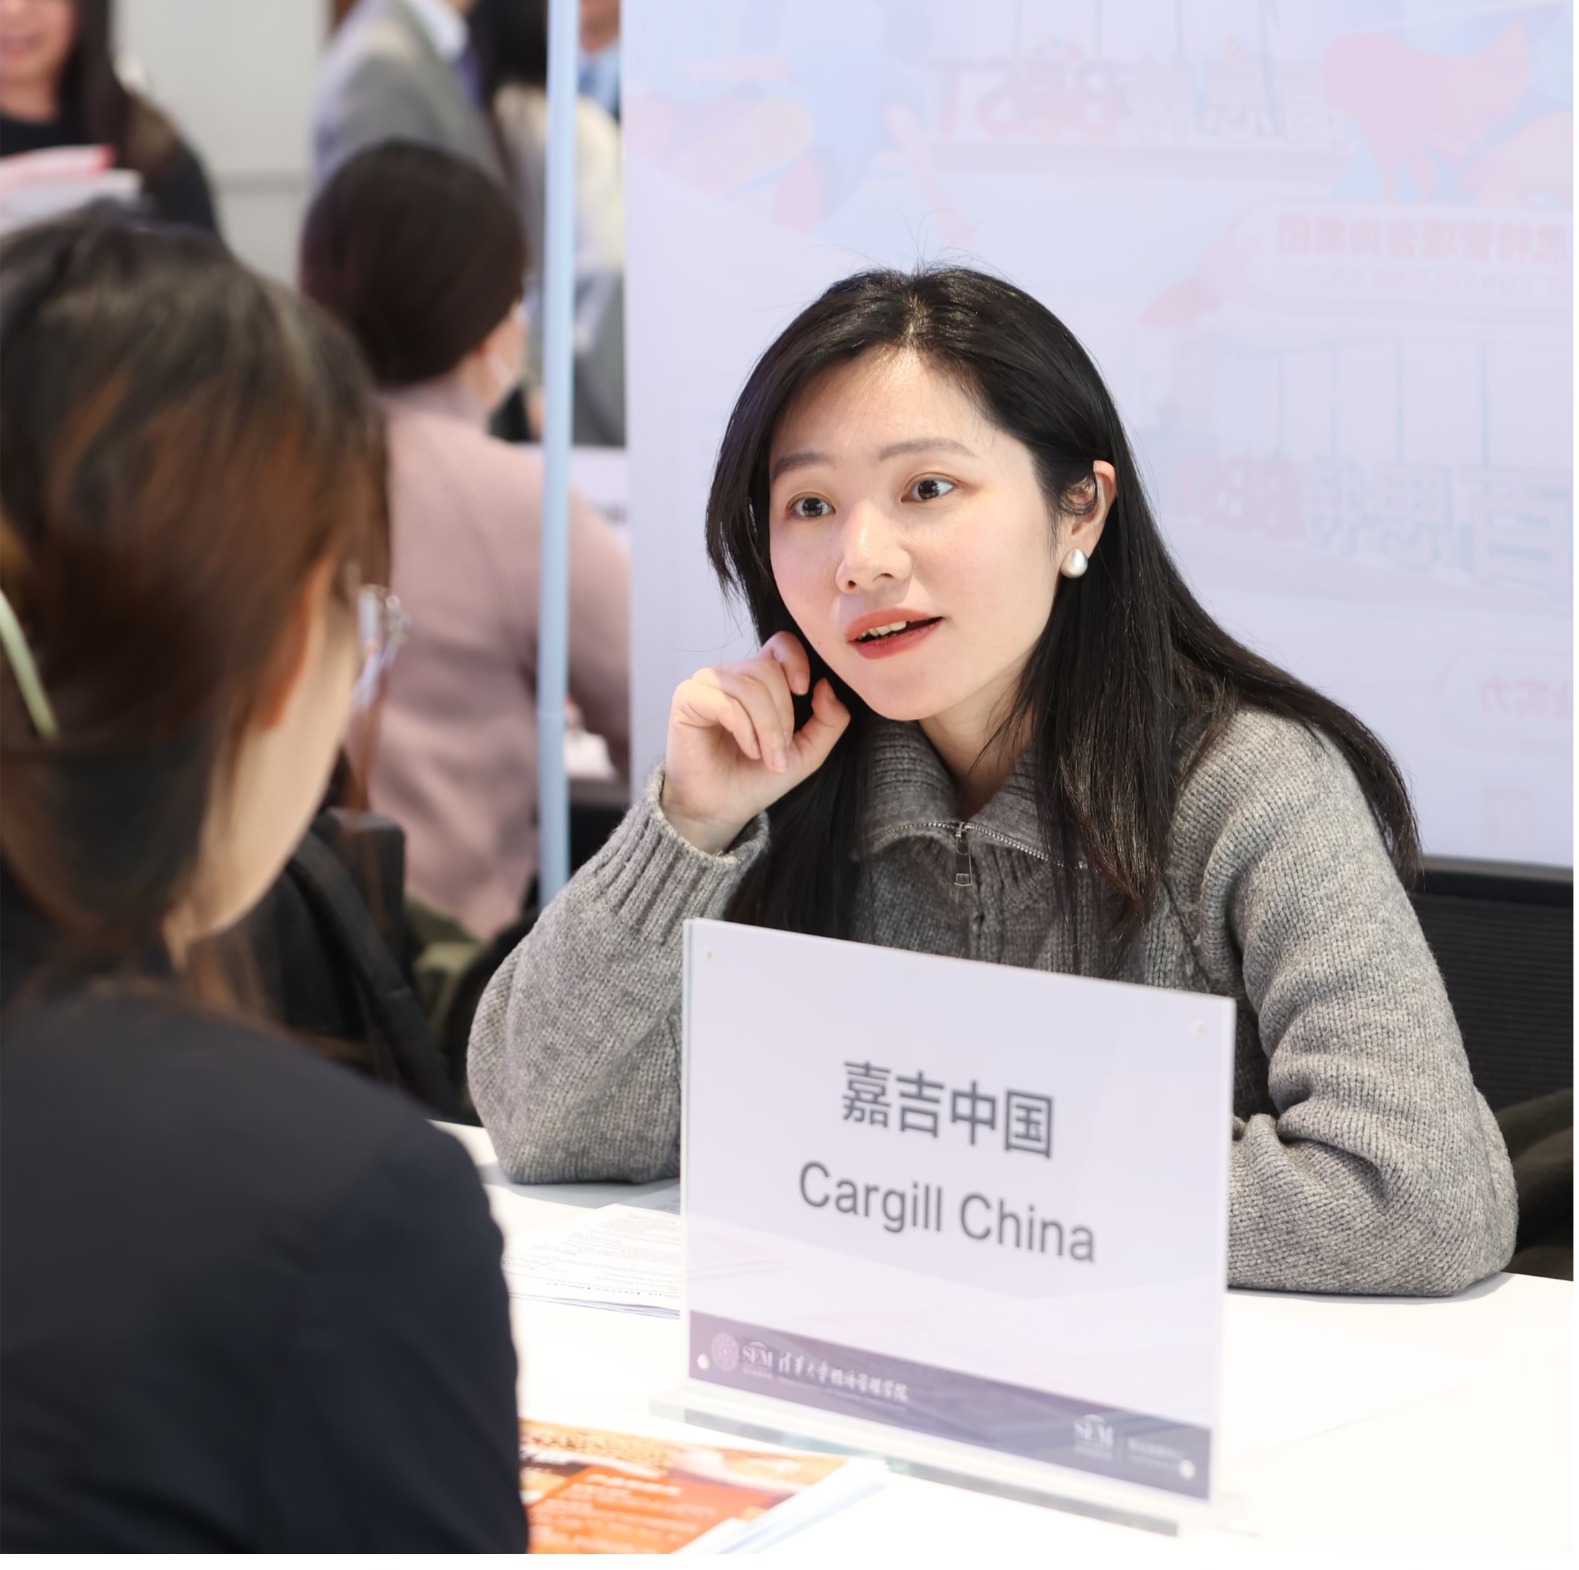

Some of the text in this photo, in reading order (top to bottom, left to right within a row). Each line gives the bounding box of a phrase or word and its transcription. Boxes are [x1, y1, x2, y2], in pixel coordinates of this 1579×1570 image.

[840, 1060, 1055, 1159] 嘉吉中国
[799, 1161, 1095, 1263] Cargill China
